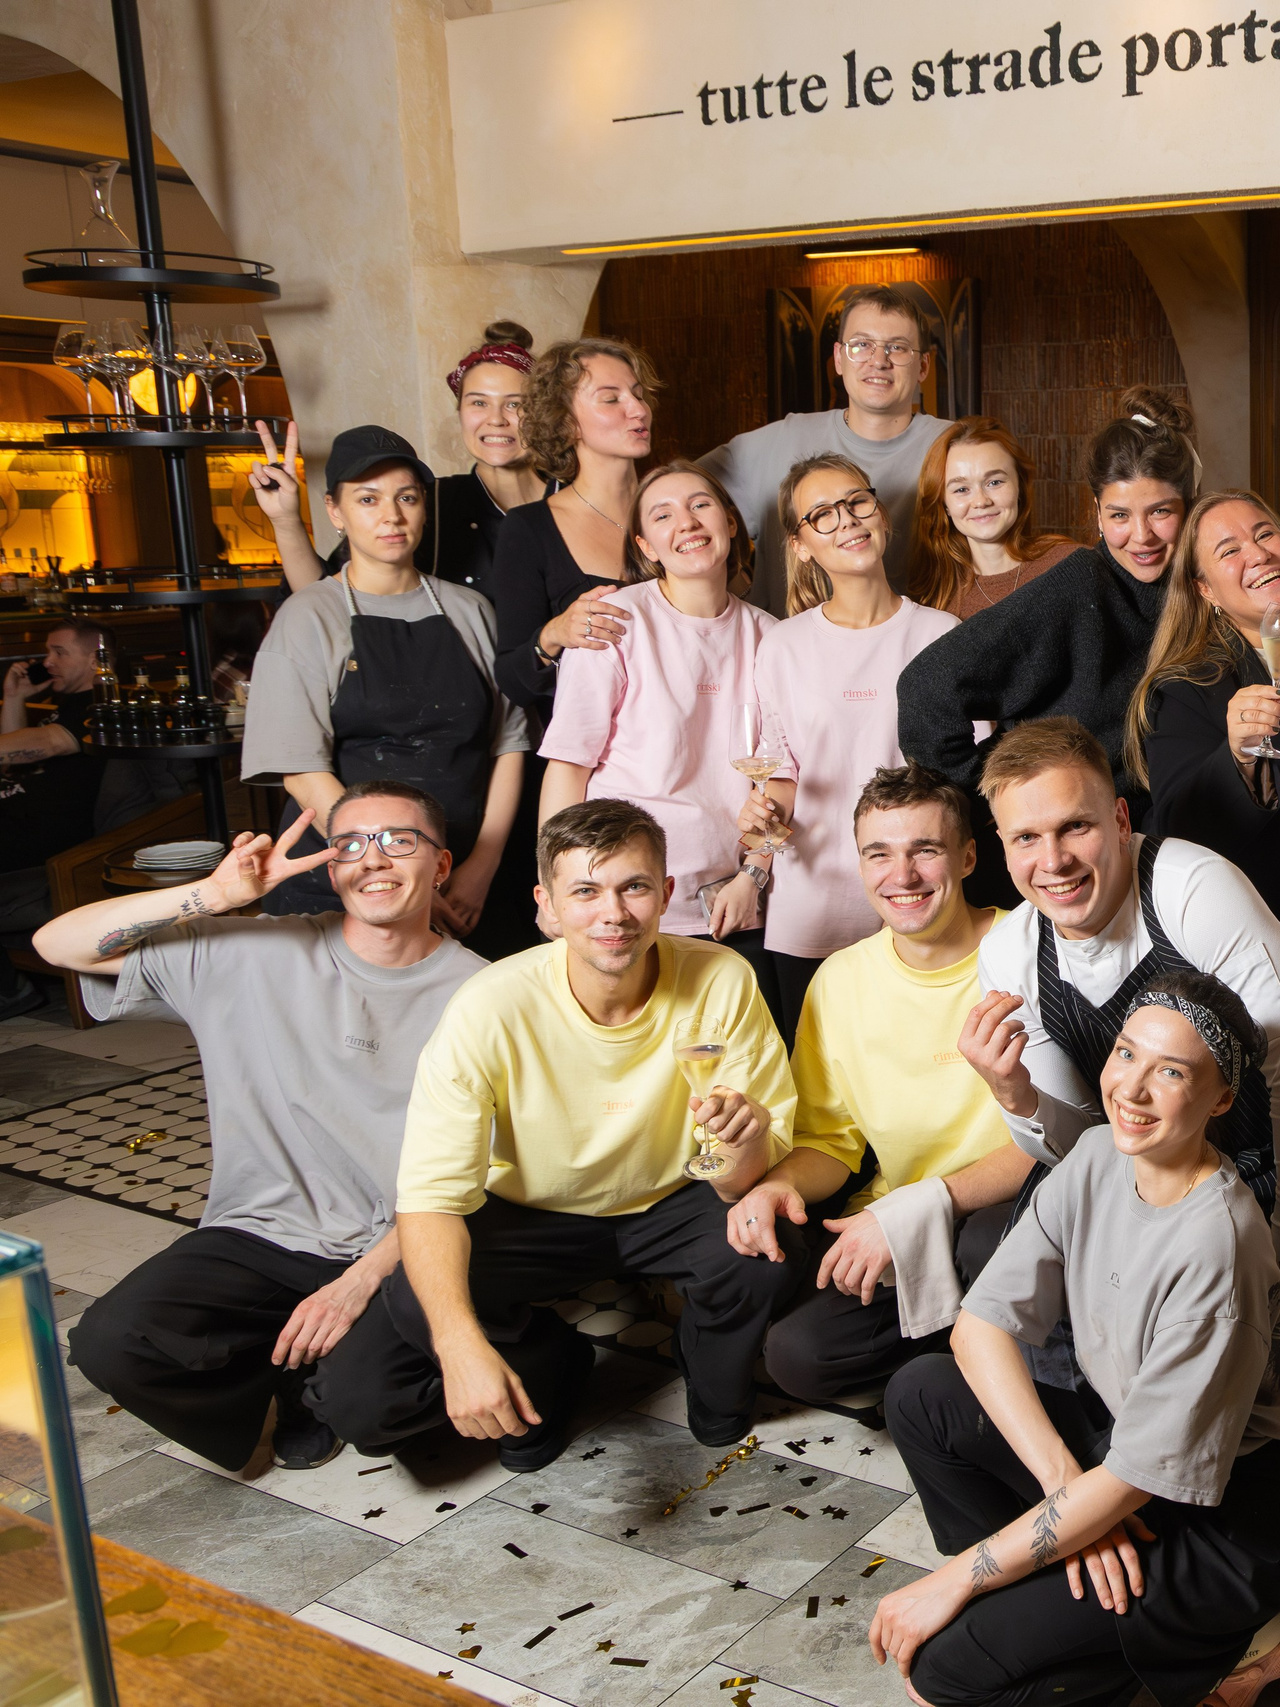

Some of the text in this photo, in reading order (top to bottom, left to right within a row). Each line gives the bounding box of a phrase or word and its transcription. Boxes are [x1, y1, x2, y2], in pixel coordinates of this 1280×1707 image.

[696, 70, 829, 126] tutte
[842, 48, 894, 106] le
[911, 18, 1102, 102] strade
[842, 688, 878, 698] rimski
[344, 1035, 380, 1051] rimski
[933, 1050, 964, 1062] rims
